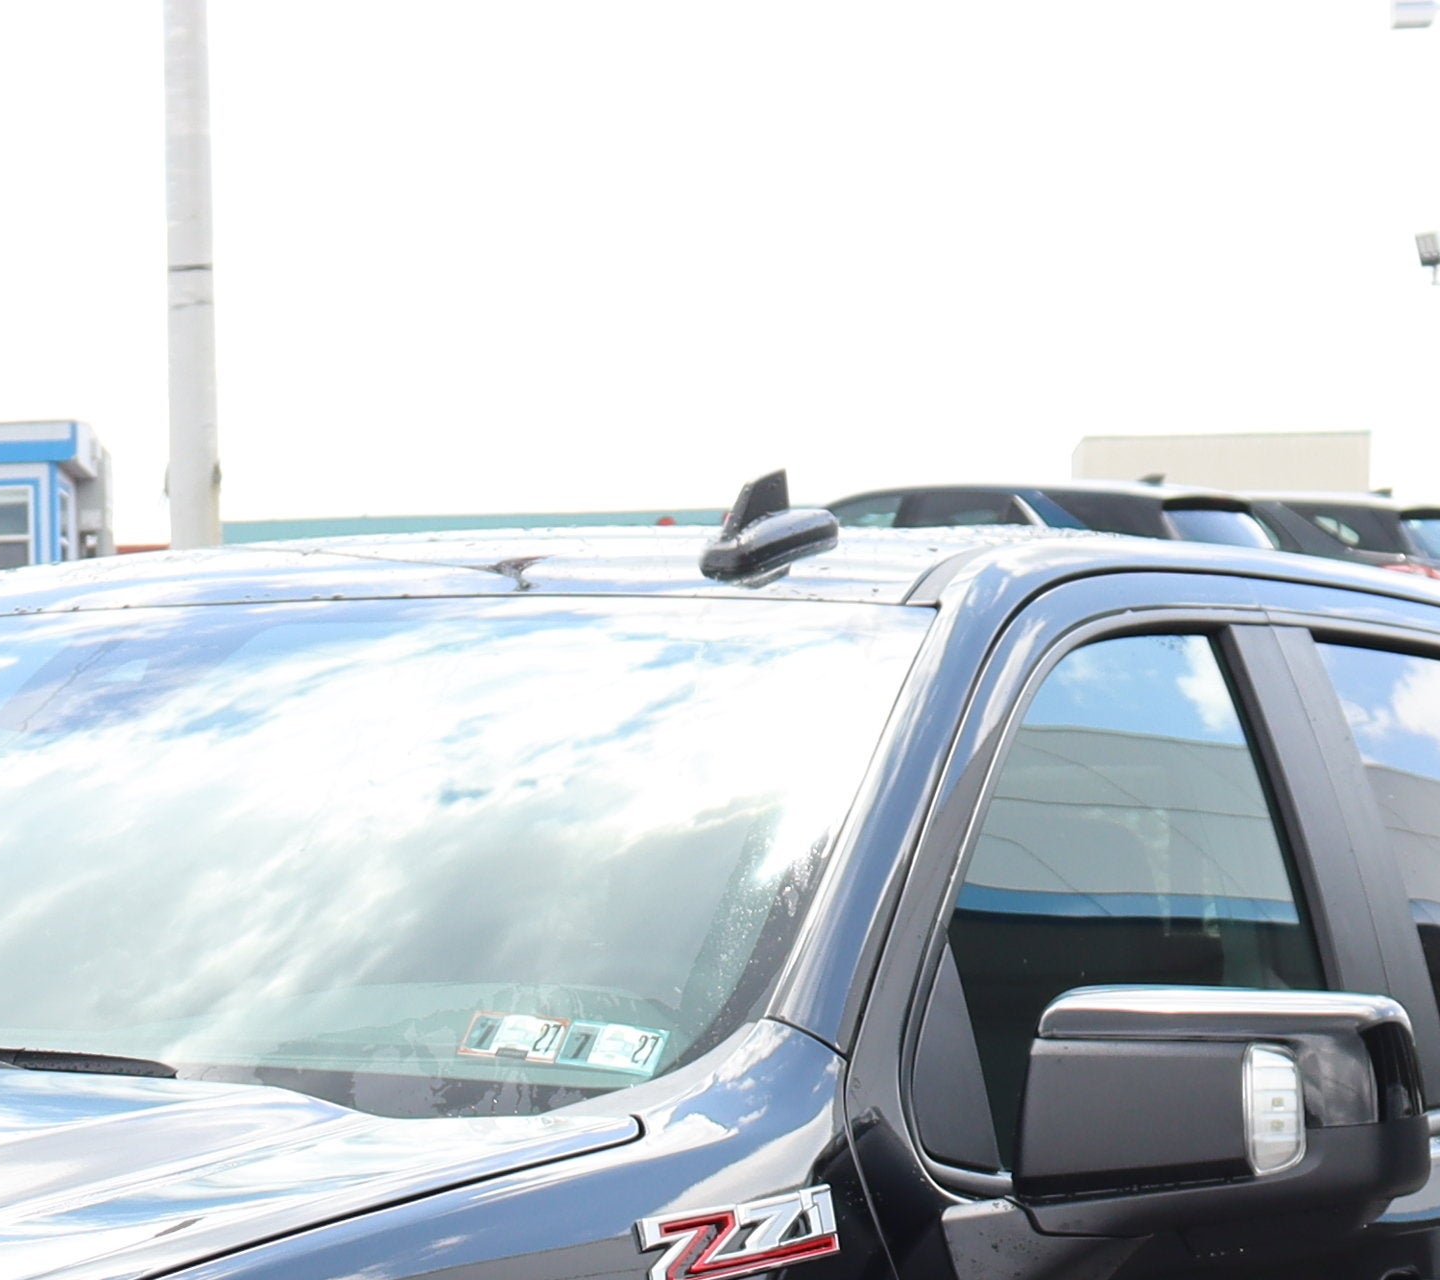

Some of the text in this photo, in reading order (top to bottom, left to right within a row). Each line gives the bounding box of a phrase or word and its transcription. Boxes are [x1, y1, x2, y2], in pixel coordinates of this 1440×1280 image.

[533, 1023, 563, 1054] 27
[575, 1033, 661, 1067] 7 27
